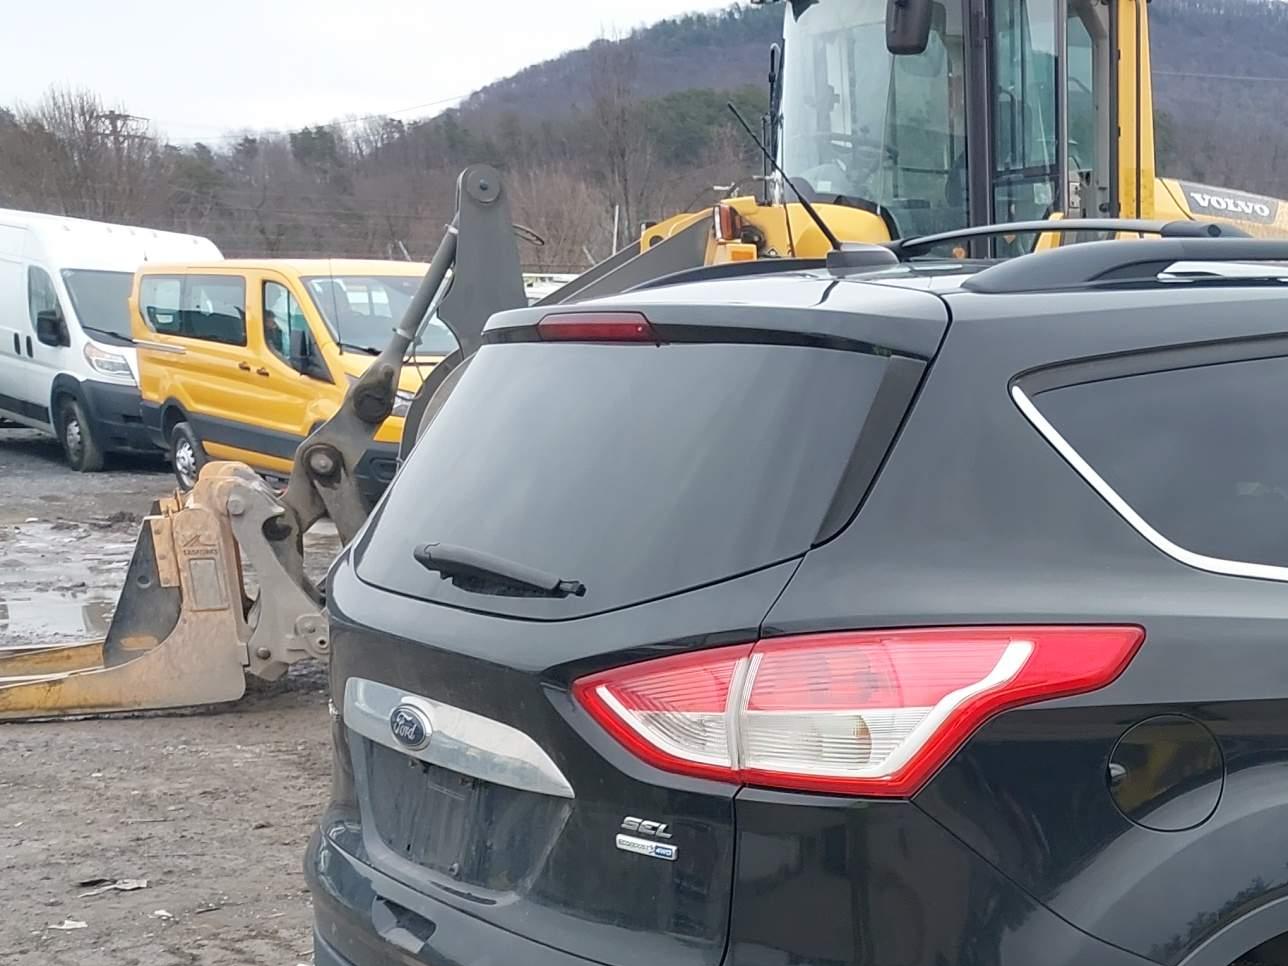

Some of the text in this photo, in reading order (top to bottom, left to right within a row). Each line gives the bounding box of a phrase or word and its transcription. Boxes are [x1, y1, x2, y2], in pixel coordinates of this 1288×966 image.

[1190, 191, 1270, 216] VOLVO
[393, 712, 416, 740] Ford
[621, 816, 672, 839] SEL
